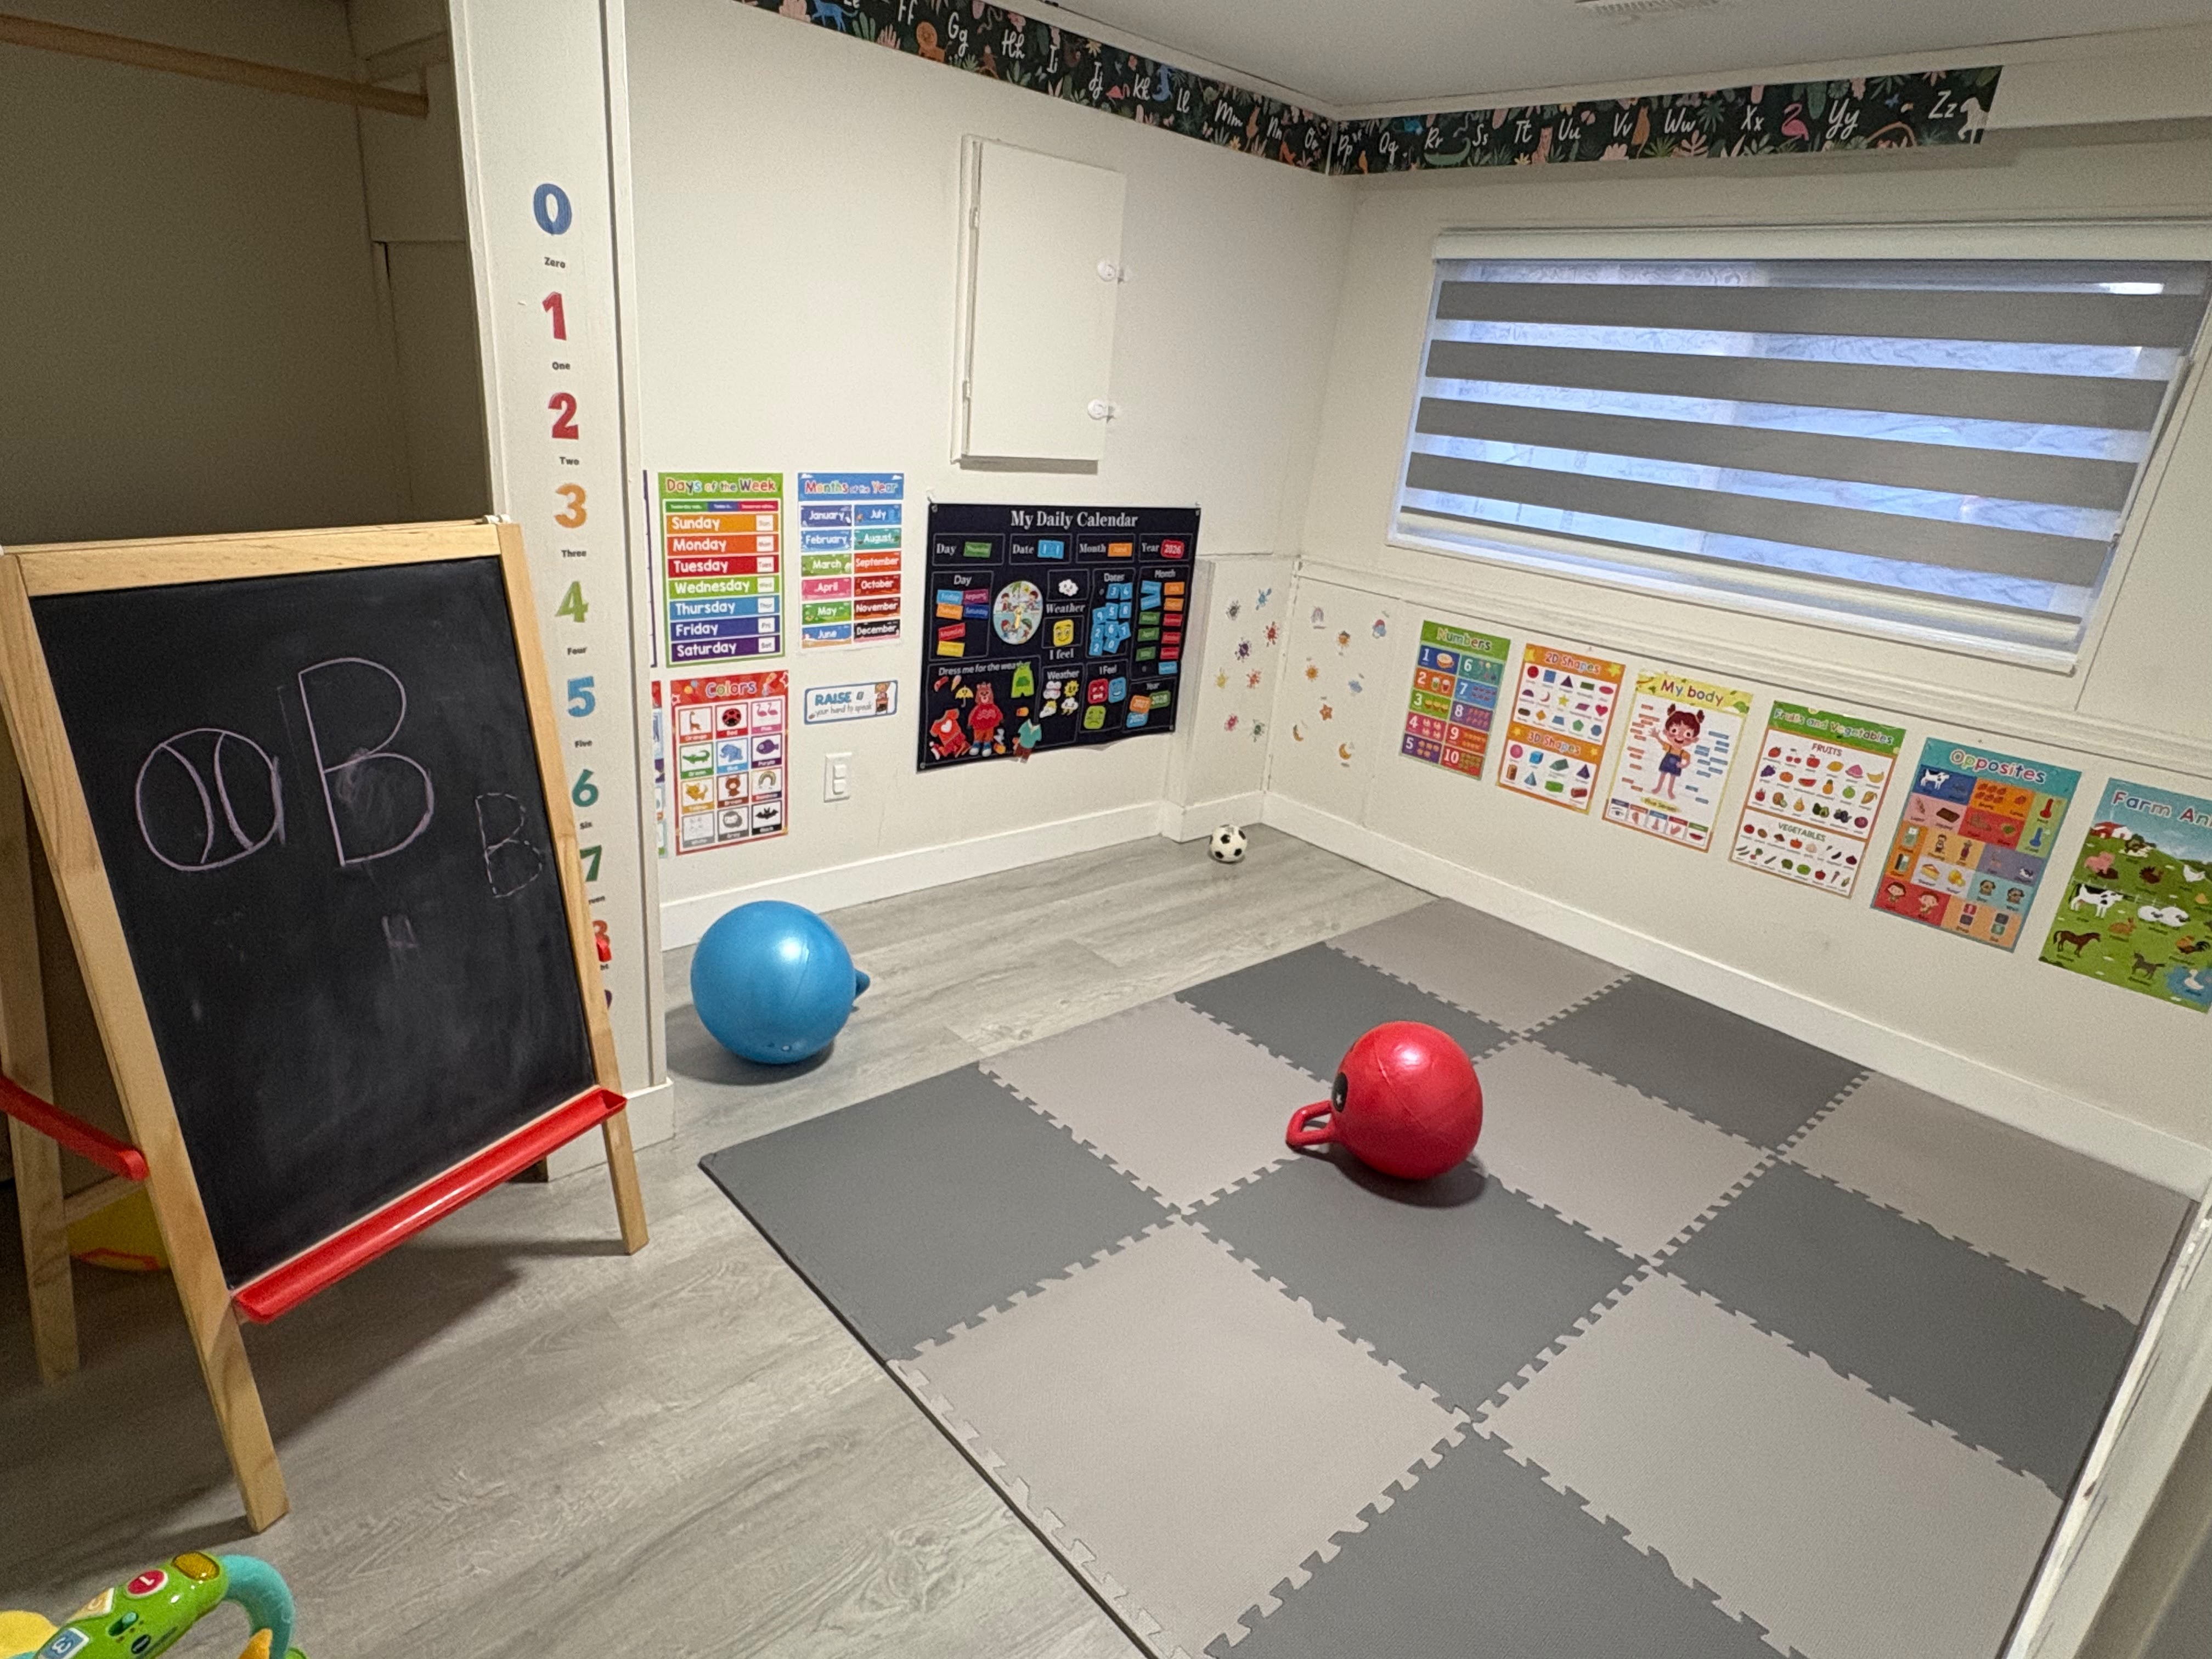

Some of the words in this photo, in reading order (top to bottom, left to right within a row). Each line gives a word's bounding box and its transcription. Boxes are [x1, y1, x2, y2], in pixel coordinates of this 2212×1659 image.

[948, 12, 969, 57] Gg
[1002, 29, 1026, 59] Hh
[1047, 44, 1058, 74] Ii
[1088, 61, 1103, 99] Jj
[1133, 74, 1150, 100] Kk
[1177, 88, 1190, 113] Ll
[1215, 100, 1243, 127] Mm
[1267, 117, 1283, 140] Nn
[1305, 127, 1319, 151] Oo
[1338, 134, 1353, 156] Pp
[1379, 133, 1399, 164] Qq
[1425, 127, 1443, 149] Rr
[1472, 124, 1488, 146] Ss
[1514, 120, 1533, 144] Tt
[1558, 119, 1582, 141] Uu
[1612, 112, 1633, 137] Vv
[1664, 108, 1696, 134] Ww
[1740, 105, 1765, 132] Xx
[1826, 99, 1860, 140] Yy
[1928, 91, 1955, 119] Zz
[534, 183, 572, 235] 0
[544, 257, 566, 269] Zero
[542, 291, 567, 341] 1
[552, 361, 571, 371] One
[548, 392, 579, 439] 2
[559, 456, 579, 466] Two
[666, 478, 702, 495] Days
[704, 479, 718, 493] of
[720, 481, 737, 493] the
[738, 478, 777, 493] Week
[805, 479, 849, 494] Months
[871, 481, 899, 494] Year
[555, 482, 588, 528] 3
[809, 510, 845, 521] January
[871, 509, 887, 521] July
[1010, 511, 1034, 530] My
[1037, 510, 1074, 529] Daily
[1076, 511, 1139, 528] Calendar
[672, 516, 720, 532] Sunday
[673, 538, 727, 552] Monday
[805, 534, 847, 545] February
[864, 533, 893, 543] August
[561, 549, 587, 558] Three
[936, 544, 957, 556] Day
[1012, 545, 1035, 554] Date
[1079, 543, 1106, 554] Month
[1141, 543, 1160, 553] Year
[674, 558, 729, 573] Tuesday
[812, 559, 842, 569] March
[856, 557, 899, 568] September
[674, 579, 751, 594] Wednesday
[817, 582, 839, 593] April
[861, 579, 895, 589] October
[953, 575, 972, 586] Day
[555, 580, 589, 623] 4
[675, 601, 736, 616] Thursday
[856, 602, 899, 613] November
[1046, 603, 1086, 613] Weather
[817, 606, 837, 617] May
[1109, 606, 1115, 616] 5
[676, 622, 719, 637] Friday
[817, 630, 837, 639] June
[856, 624, 897, 635] December
[1436, 627, 1492, 651] Numbers
[567, 646, 588, 656] Four
[677, 641, 737, 657] Saturday
[1049, 650, 1054, 660] I
[1057, 648, 1074, 659] feel
[1422, 648, 1430, 662] 1
[939, 667, 961, 676] Dress
[975, 664, 986, 673] for
[988, 663, 1000, 672] the
[1464, 658, 1473, 672] 6
[1545, 652, 1559, 664] 2D
[1562, 656, 1601, 674] Shapes
[1047, 670, 1080, 680] Weather
[1417, 672, 1426, 685] 2
[705, 680, 757, 698] Colors
[1459, 681, 1469, 695] 7
[1661, 679, 1684, 697] My
[1687, 685, 1724, 707] body
[567, 676, 596, 718] 5
[815, 691, 852, 706] RAISE
[1413, 693, 1423, 706] 3
[831, 704, 846, 714] hand
[1454, 704, 1464, 718] 8
[1409, 715, 1418, 729] 4
[1773, 708, 1805, 725] Fruits
[1807, 718, 1829, 730] and
[1830, 721, 1894, 744] Vegetables
[1451, 726, 1459, 740] 9
[574, 738, 592, 748] Five
[1406, 736, 1414, 749] 5
[1527, 731, 1541, 743] 3D
[1543, 735, 1581, 754] Shapes
[1444, 748, 1460, 764] 10
[1812, 743, 1843, 757] FRUITS
[298, 656, 434, 866] B
[1950, 748, 2047, 785] Opposites
[572, 769, 599, 808] 6
[2112, 790, 2172, 818] Farm
[579, 820, 593, 830] Six
[1778, 822, 1827, 842] VEGETABLES
[475, 792, 543, 898] B
[578, 844, 602, 882] 7
[52, 1637, 71, 1654] 3
